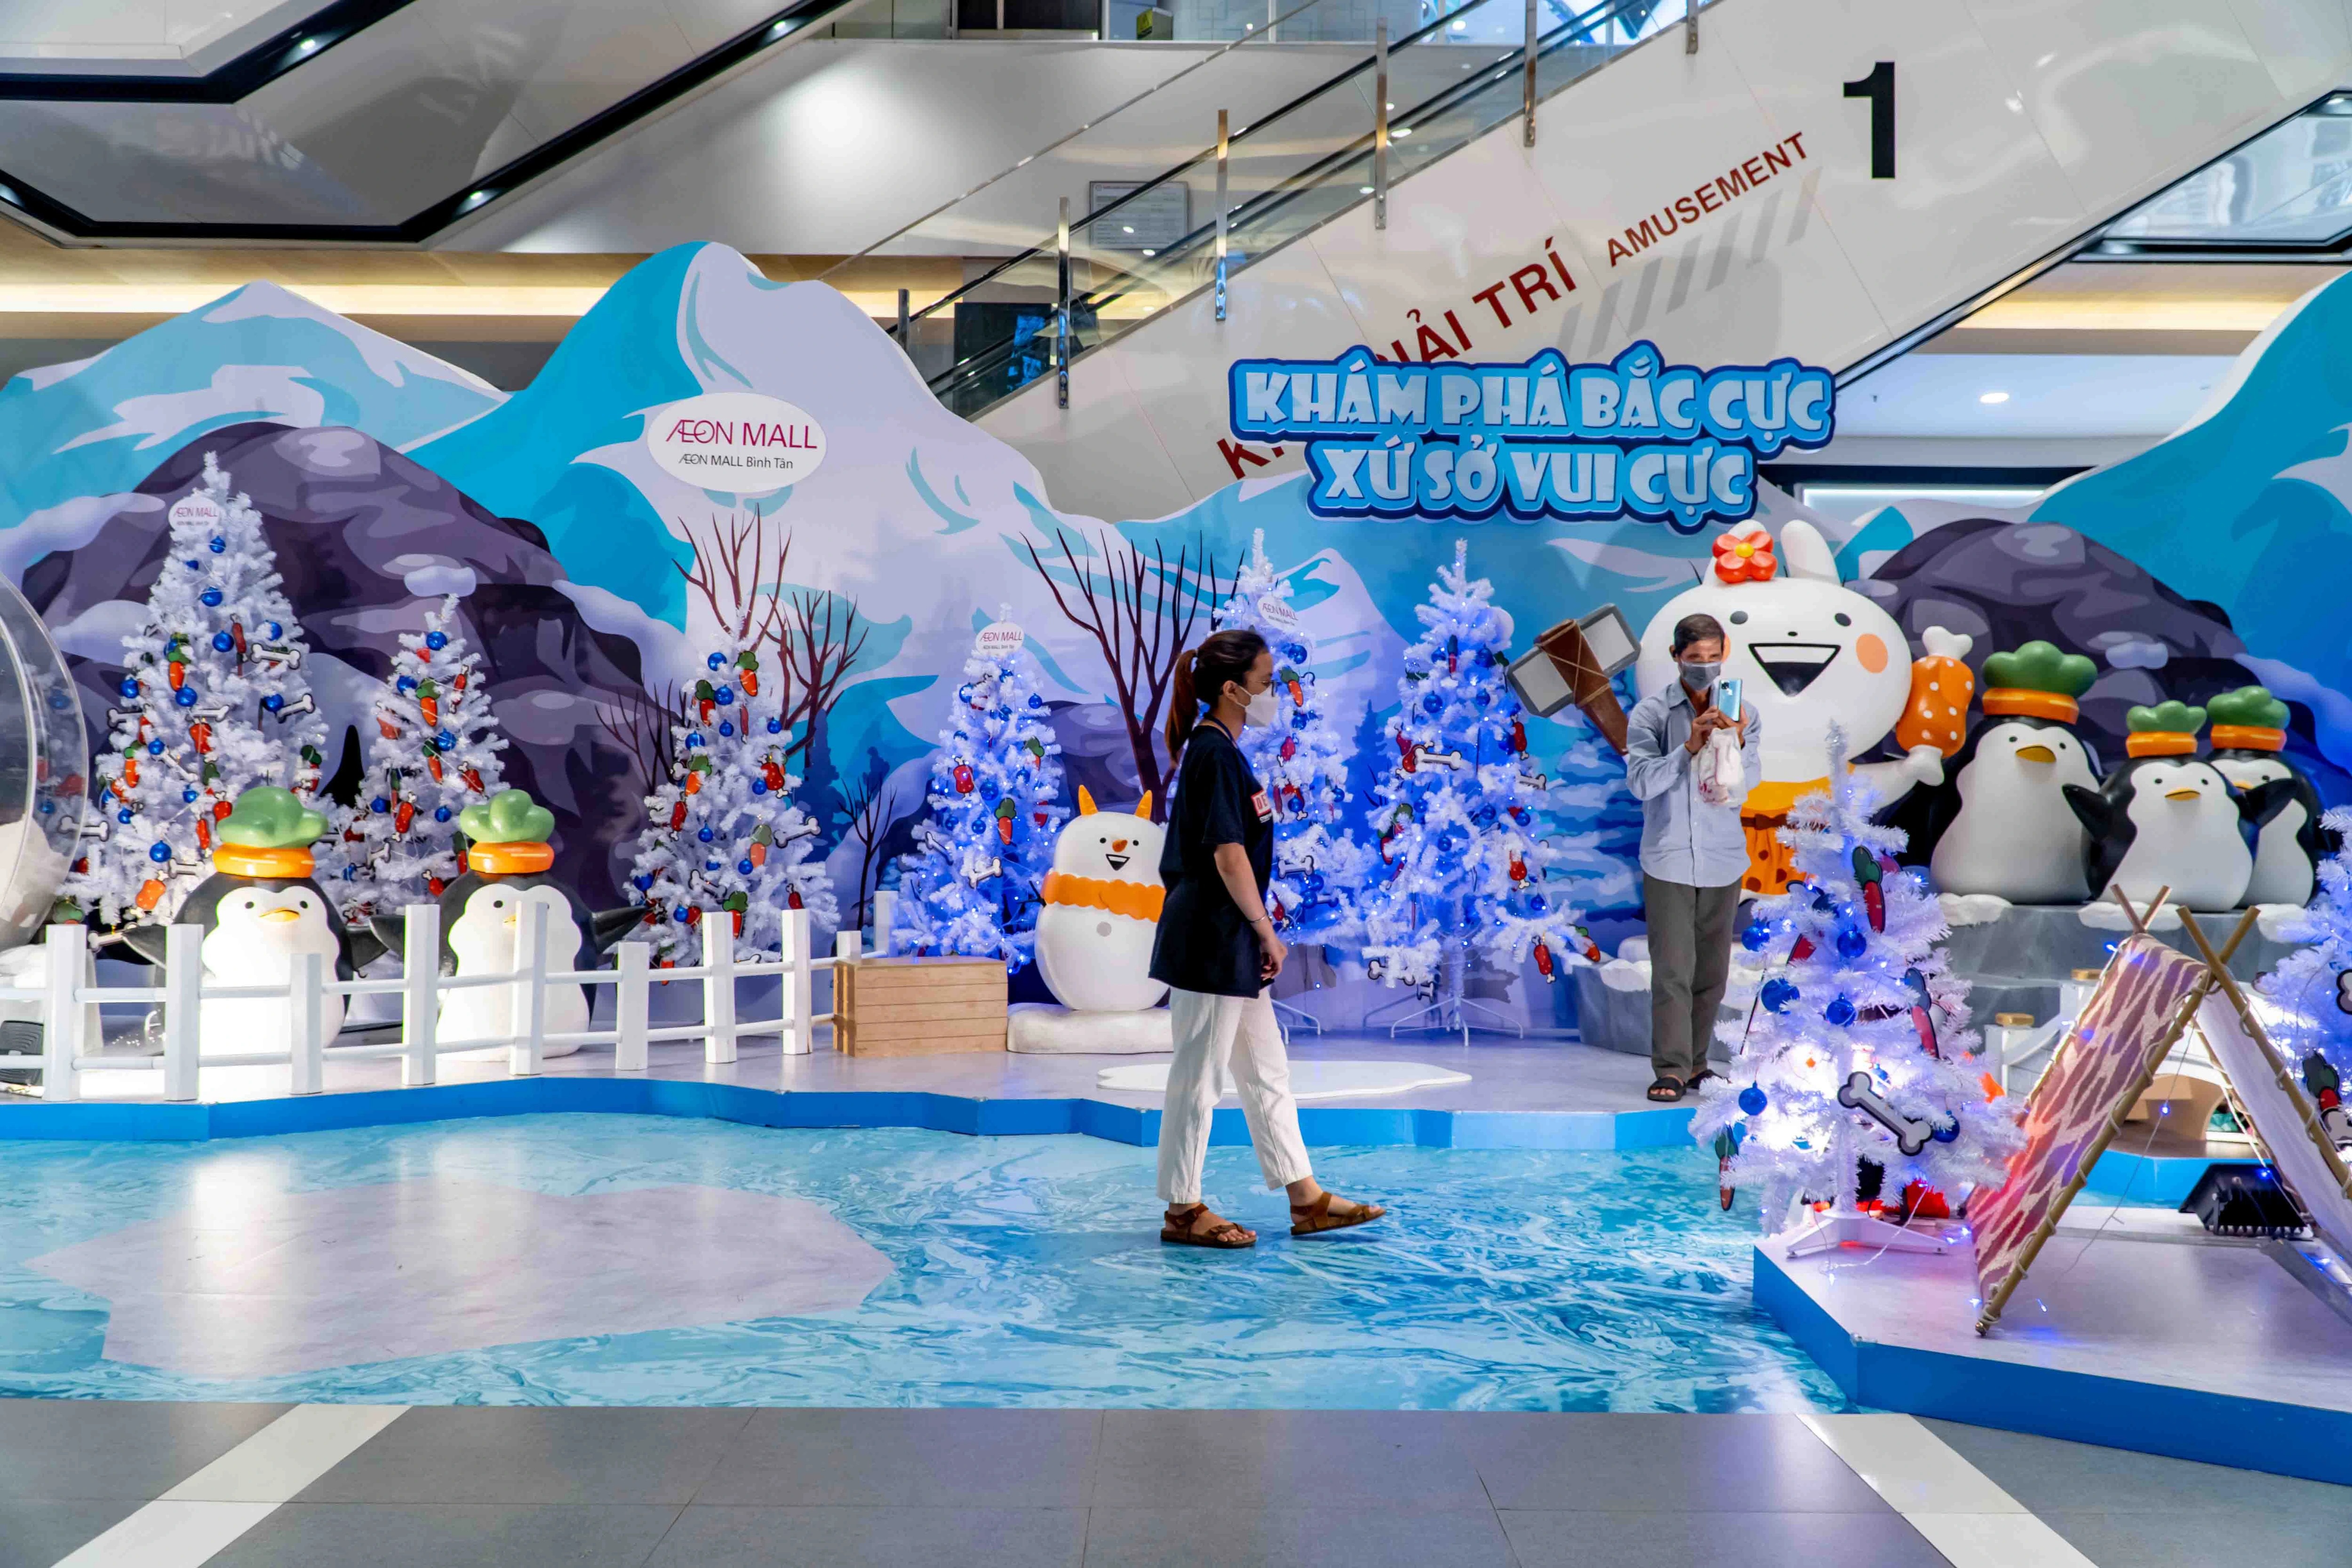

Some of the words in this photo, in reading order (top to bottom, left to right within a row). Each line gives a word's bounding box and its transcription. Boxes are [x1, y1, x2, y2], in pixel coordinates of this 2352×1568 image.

[1843, 62, 1895, 178] 1
[1473, 236, 1576, 328] TRÍ
[1607, 132, 1808, 267] AMUSEMENT
[742, 422, 818, 449] MALL
[1246, 359, 1427, 424] KHÁM
[1441, 362, 1567, 426] PHÁ
[1581, 355, 1695, 429] BẮC
[1708, 372, 1823, 442] CỰC
[710, 454, 743, 467] MALL
[746, 455, 771, 469] Bình
[773, 457, 794, 469] Tân
[1323, 434, 1415, 500] XỨ
[1424, 434, 1499, 502] SỞ
[1510, 452, 1616, 502] VUI
[1630, 445, 1745, 516] CỰC
[1001, 631, 1022, 641] MALL
